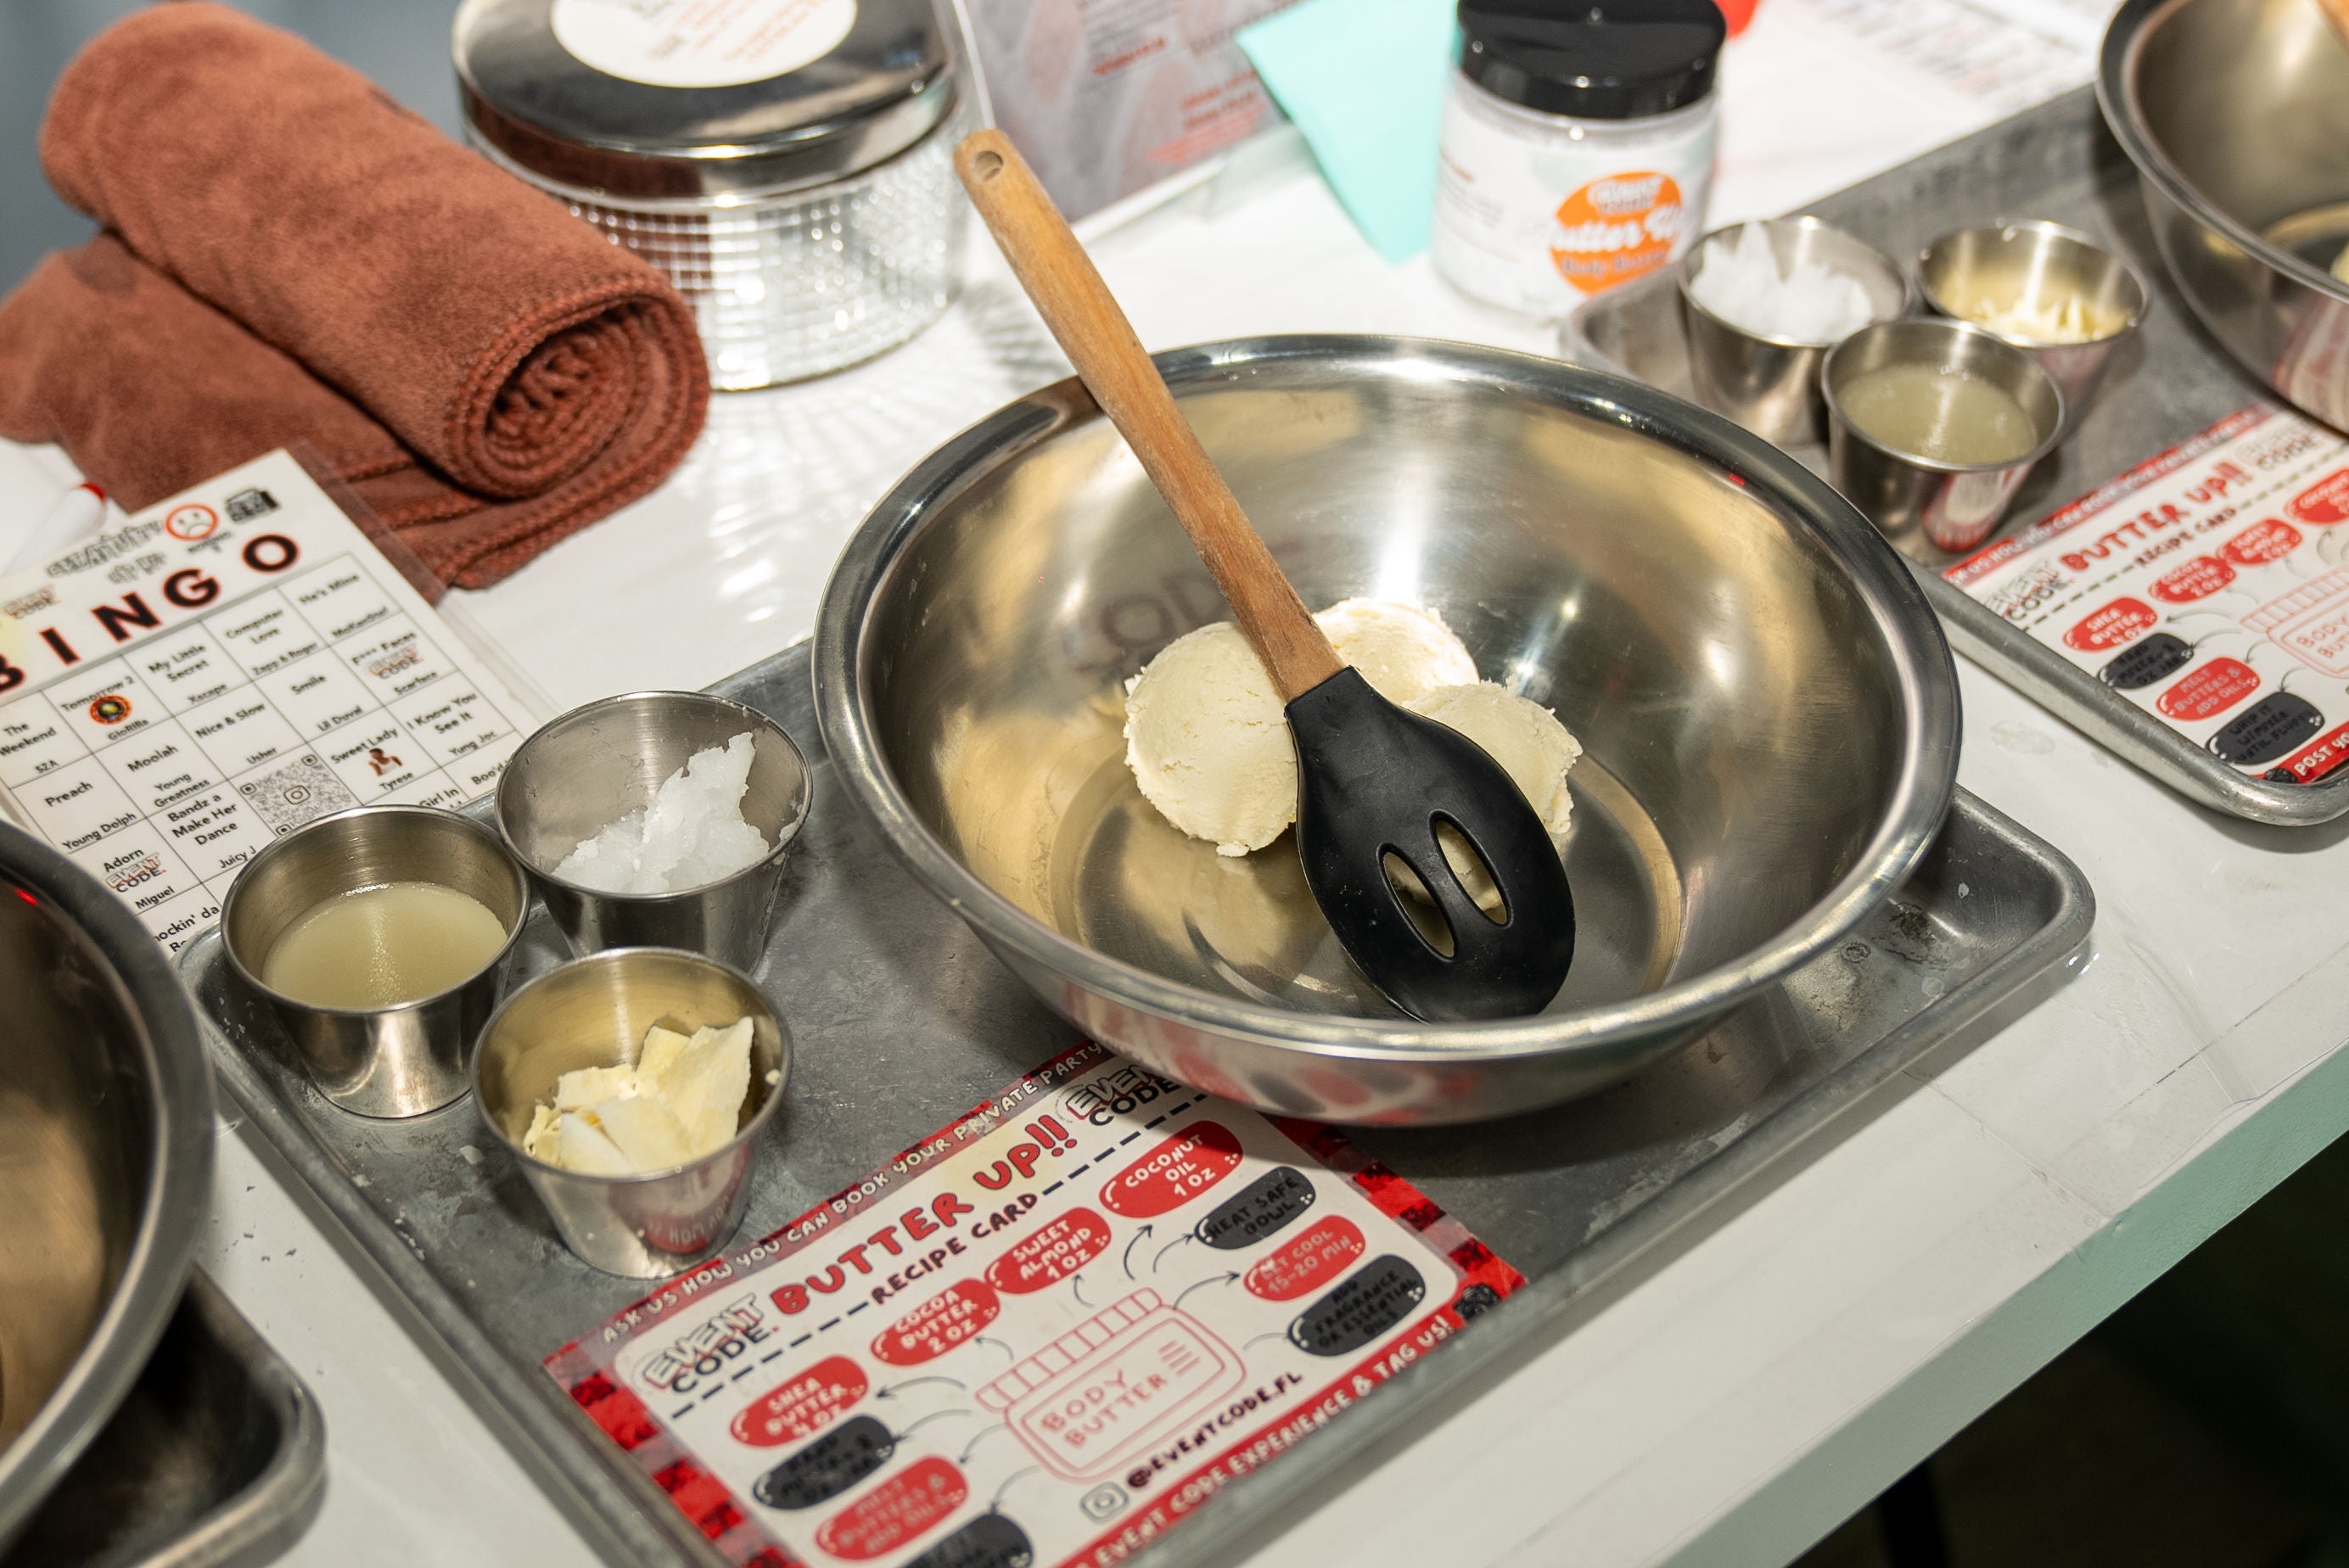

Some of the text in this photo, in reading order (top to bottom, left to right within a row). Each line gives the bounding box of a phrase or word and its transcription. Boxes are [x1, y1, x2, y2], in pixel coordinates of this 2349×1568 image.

[2060, 503, 2191, 573] BUTTER
[148, 643, 207, 674] My Little
[166, 659, 210, 682] Secret
[60, 675, 137, 713] Tomorrow 2
[290, 675, 327, 695] Smile
[194, 703, 266, 739] Nice & Slow
[413, 705, 452, 726] Know
[451, 692, 478, 708] You
[434, 717, 460, 735] See
[0, 726, 58, 757] Weekend
[3, 722, 30, 737] The
[330, 726, 399, 764] Sweet Lady
[126, 744, 180, 773] Moolah
[245, 746, 278, 765] Usher
[447, 740, 479, 757] Yung
[2293, 745, 2334, 777] POST
[34, 759, 60, 774] SZA
[154, 772, 193, 792] Young
[378, 771, 415, 792] Tyrese
[44, 781, 94, 807] Preach
[153, 779, 211, 809] Greatness
[167, 798, 212, 823] Bandz
[419, 790, 445, 808] Girl
[443, 787, 461, 800] In
[62, 811, 137, 851] Young Dolph
[171, 803, 238, 838] Make Her
[194, 821, 238, 846] Dance
[102, 848, 146, 873] Adorn
[104, 852, 161, 891] EVENT
[219, 850, 249, 870] Juicy
[134, 885, 176, 910] Miguel
[200, 904, 221, 920] da
[1065, 1063, 1156, 1121] EVEN
[1124, 1134, 1204, 1189] COCONUT
[1163, 1161, 1198, 1183] OIL
[603, 1042, 1104, 1346] ASK US HOW YOU CAN BOOK YOUR PRIVATE PARTY
[1173, 1167, 1217, 1198] 1 OZ
[769, 1191, 976, 1315] BUTTER
[973, 1113, 1079, 1191] UP!!
[1205, 1176, 1300, 1240] HEAT SAFE
[1242, 1201, 1297, 1236] BOWL
[870, 1192, 1039, 1306] RECIPE CARD
[1012, 1218, 1071, 1263] SWEET
[1018, 1226, 1093, 1281] ALMOND
[1291, 1229, 1335, 1260] COOL
[1046, 1247, 1094, 1280] 1 OZ
[1267, 1234, 1353, 1295] 15-20 MIN
[894, 1289, 961, 1334] COCOA
[900, 1298, 979, 1351] BUTTER
[642, 1291, 765, 1391] EVENT
[926, 1317, 978, 1354] 2 OZ
[765, 1382, 849, 1436] BUTTER
[766, 1376, 822, 1414] SHEA
[1040, 1369, 1130, 1432] BODY
[1063, 1372, 1169, 1448] BUTTER
[1093, 1313, 1456, 1568] EVENT CODE EXPERIENCE & TAG US!
[1126, 1370, 1303, 1490] @EVENTCODE.FL
